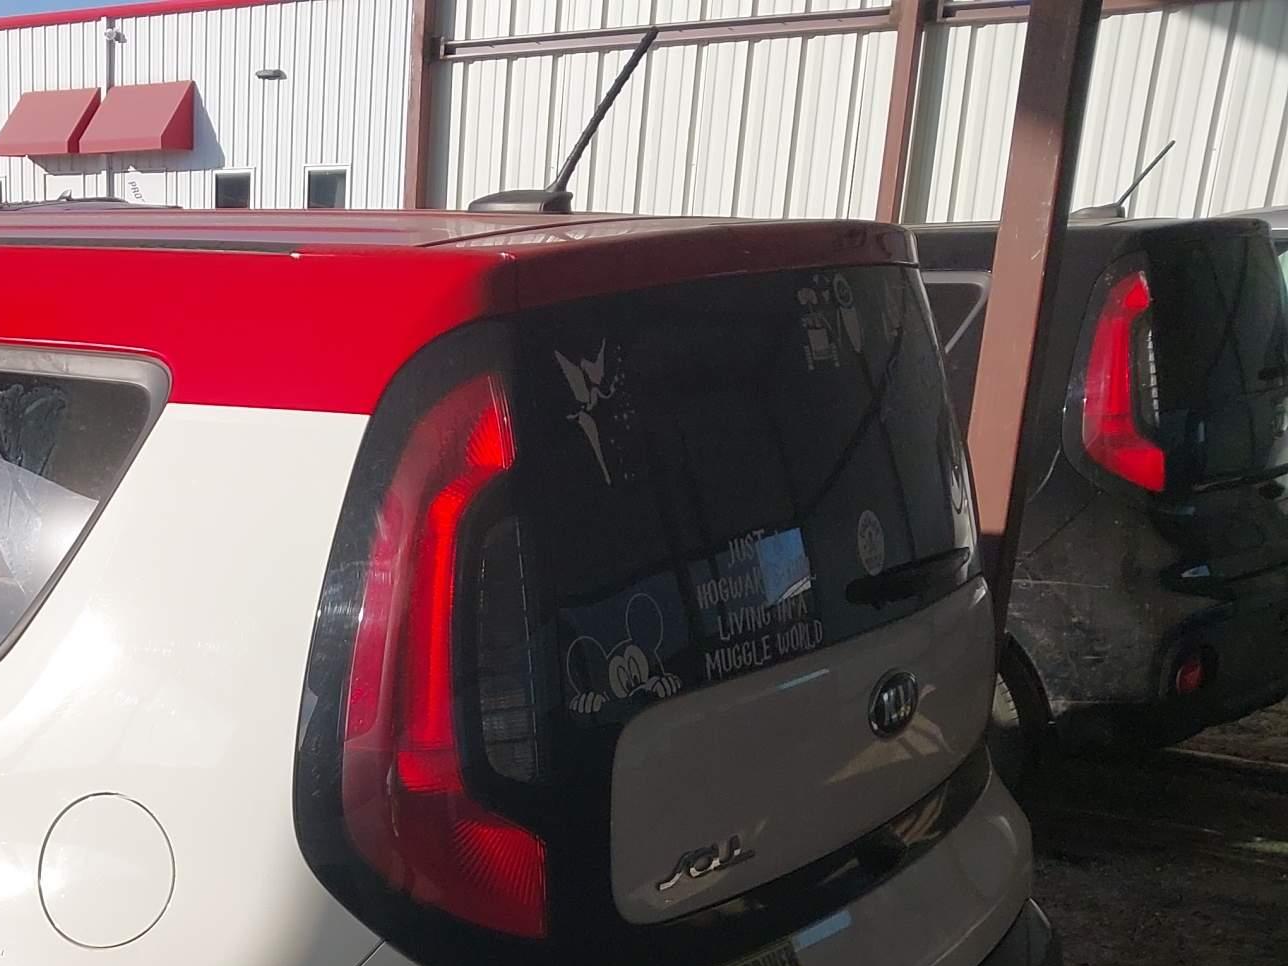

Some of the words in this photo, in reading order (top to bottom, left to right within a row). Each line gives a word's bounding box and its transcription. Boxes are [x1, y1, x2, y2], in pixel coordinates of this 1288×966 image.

[728, 528, 765, 568] JUST
[697, 562, 776, 610] HOGWAR
[717, 604, 770, 641] LIVING
[705, 635, 772, 681] MUGGLE
[777, 619, 824, 655] WORLD
